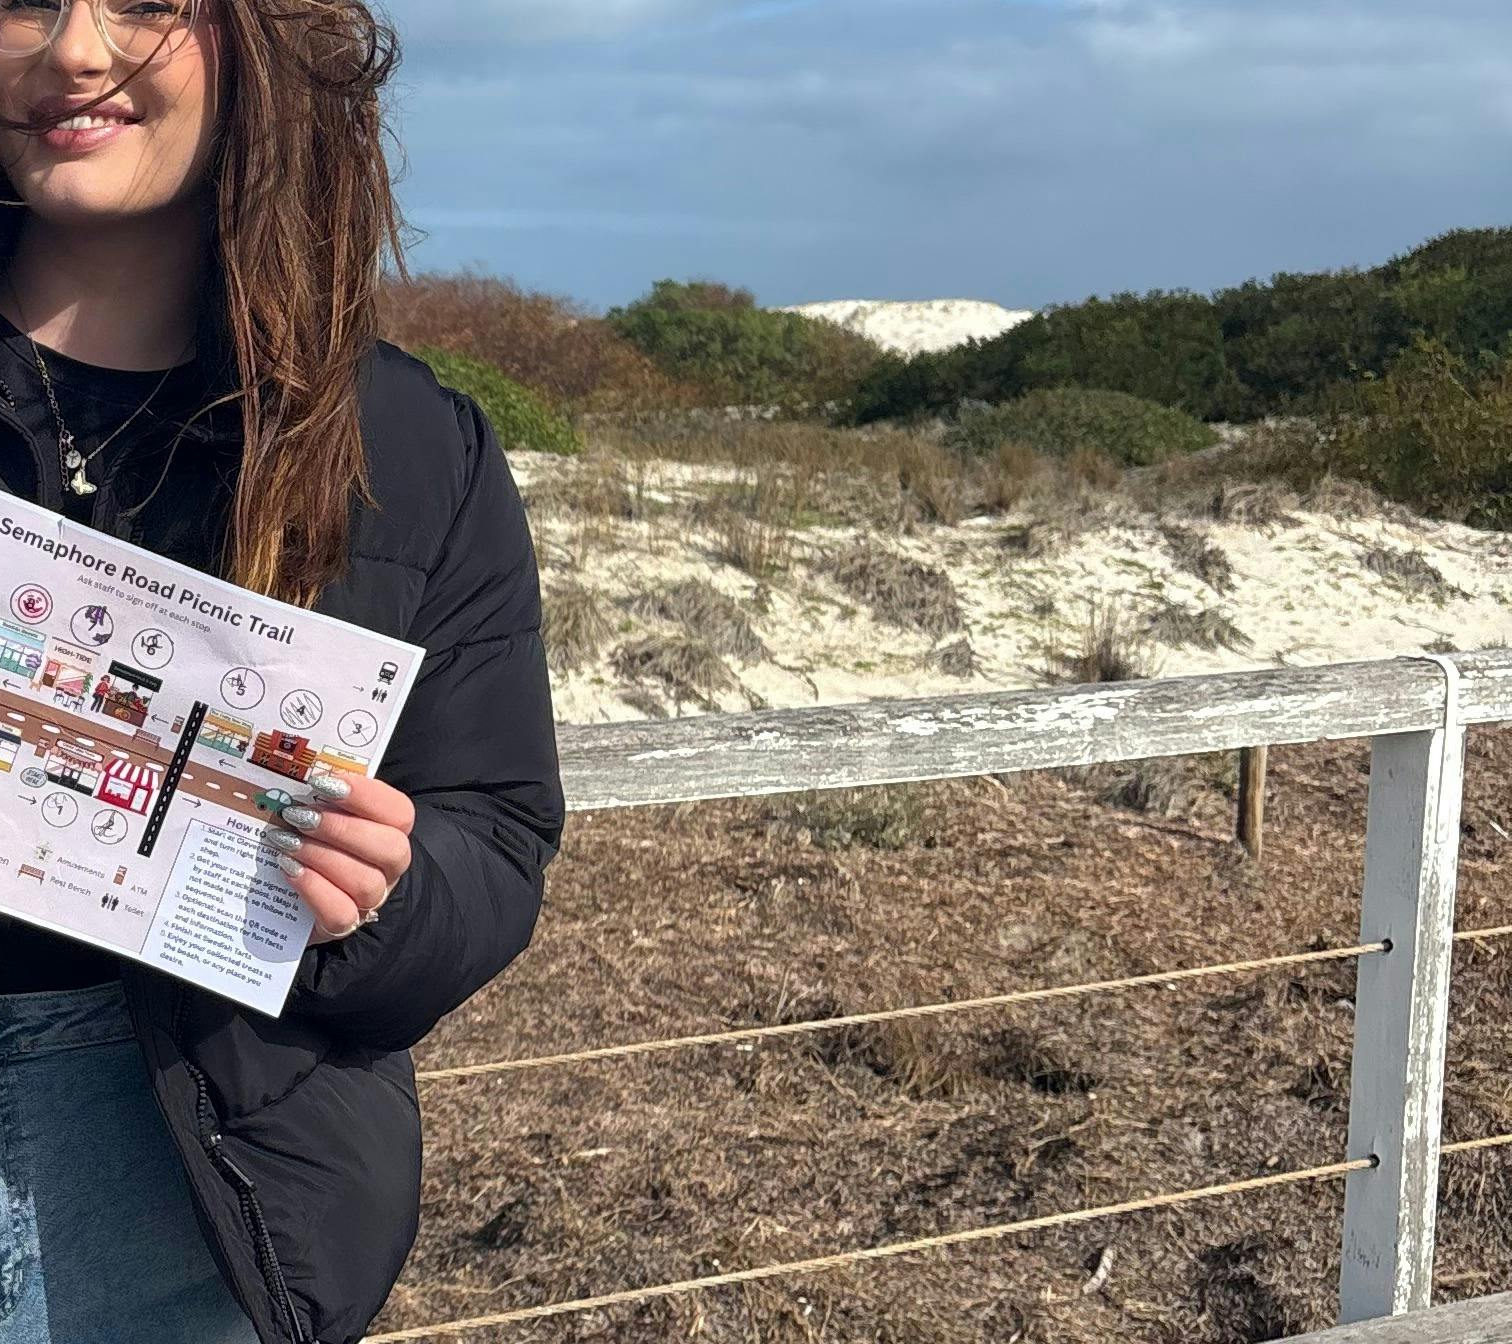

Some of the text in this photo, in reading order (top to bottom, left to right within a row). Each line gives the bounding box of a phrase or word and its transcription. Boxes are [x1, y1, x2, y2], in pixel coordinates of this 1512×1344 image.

[77, 574, 211, 633] Ask staff to sign off at each stop.
[121, 565, 176, 599] Road
[178, 588, 243, 626] Picnic
[249, 614, 295, 644] Trail
[236, 686, 246, 697] 5
[297, 704, 306, 716] 4
[353, 723, 362, 735] 3
[207, 827, 227, 838] Start
[236, 837, 261, 850] Clever
[261, 846, 281, 857] Littl
[226, 816, 267, 838] How to
[57, 856, 105, 879] Amusements
[200, 846, 219, 859] shop.
[204, 837, 280, 869] and turn right as you
[49, 875, 92, 896] Rest Bench
[130, 884, 148, 896] ATM
[192, 864, 299, 912] by staff at each point. (Map is
[196, 855, 211, 866] Get
[210, 861, 228, 872] your
[229, 867, 246, 878] trail
[245, 874, 262, 886] map
[263, 880, 288, 895] signed
[189, 875, 202, 885] not
[203, 880, 224, 892] made
[224, 888, 233, 896] to
[251, 899, 260, 907] so
[261, 901, 284, 916] follow
[285, 912, 298, 922] the
[175, 914, 234, 942] and information.
[178, 904, 284, 951] each destination for fun facts
[182, 893, 216, 911] Optional:
[217, 908, 234, 919] scan
[234, 914, 248, 925] the
[248, 920, 260, 930] QR
[260, 925, 279, 938] code
[279, 934, 288, 942] at
[168, 932, 188, 946] Enjoy
[188, 941, 206, 952] your
[207, 948, 241, 967] collected
[241, 962, 263, 977] treats
[264, 972, 272, 980] at
[171, 923, 193, 936] Finish
[194, 932, 202, 940] at
[202, 935, 233, 952] Swedish
[234, 947, 252, 960] Tarts
[163, 942, 176, 952] the
[211, 962, 225, 973] any
[225, 968, 246, 981] place
[246, 977, 262, 987] you
